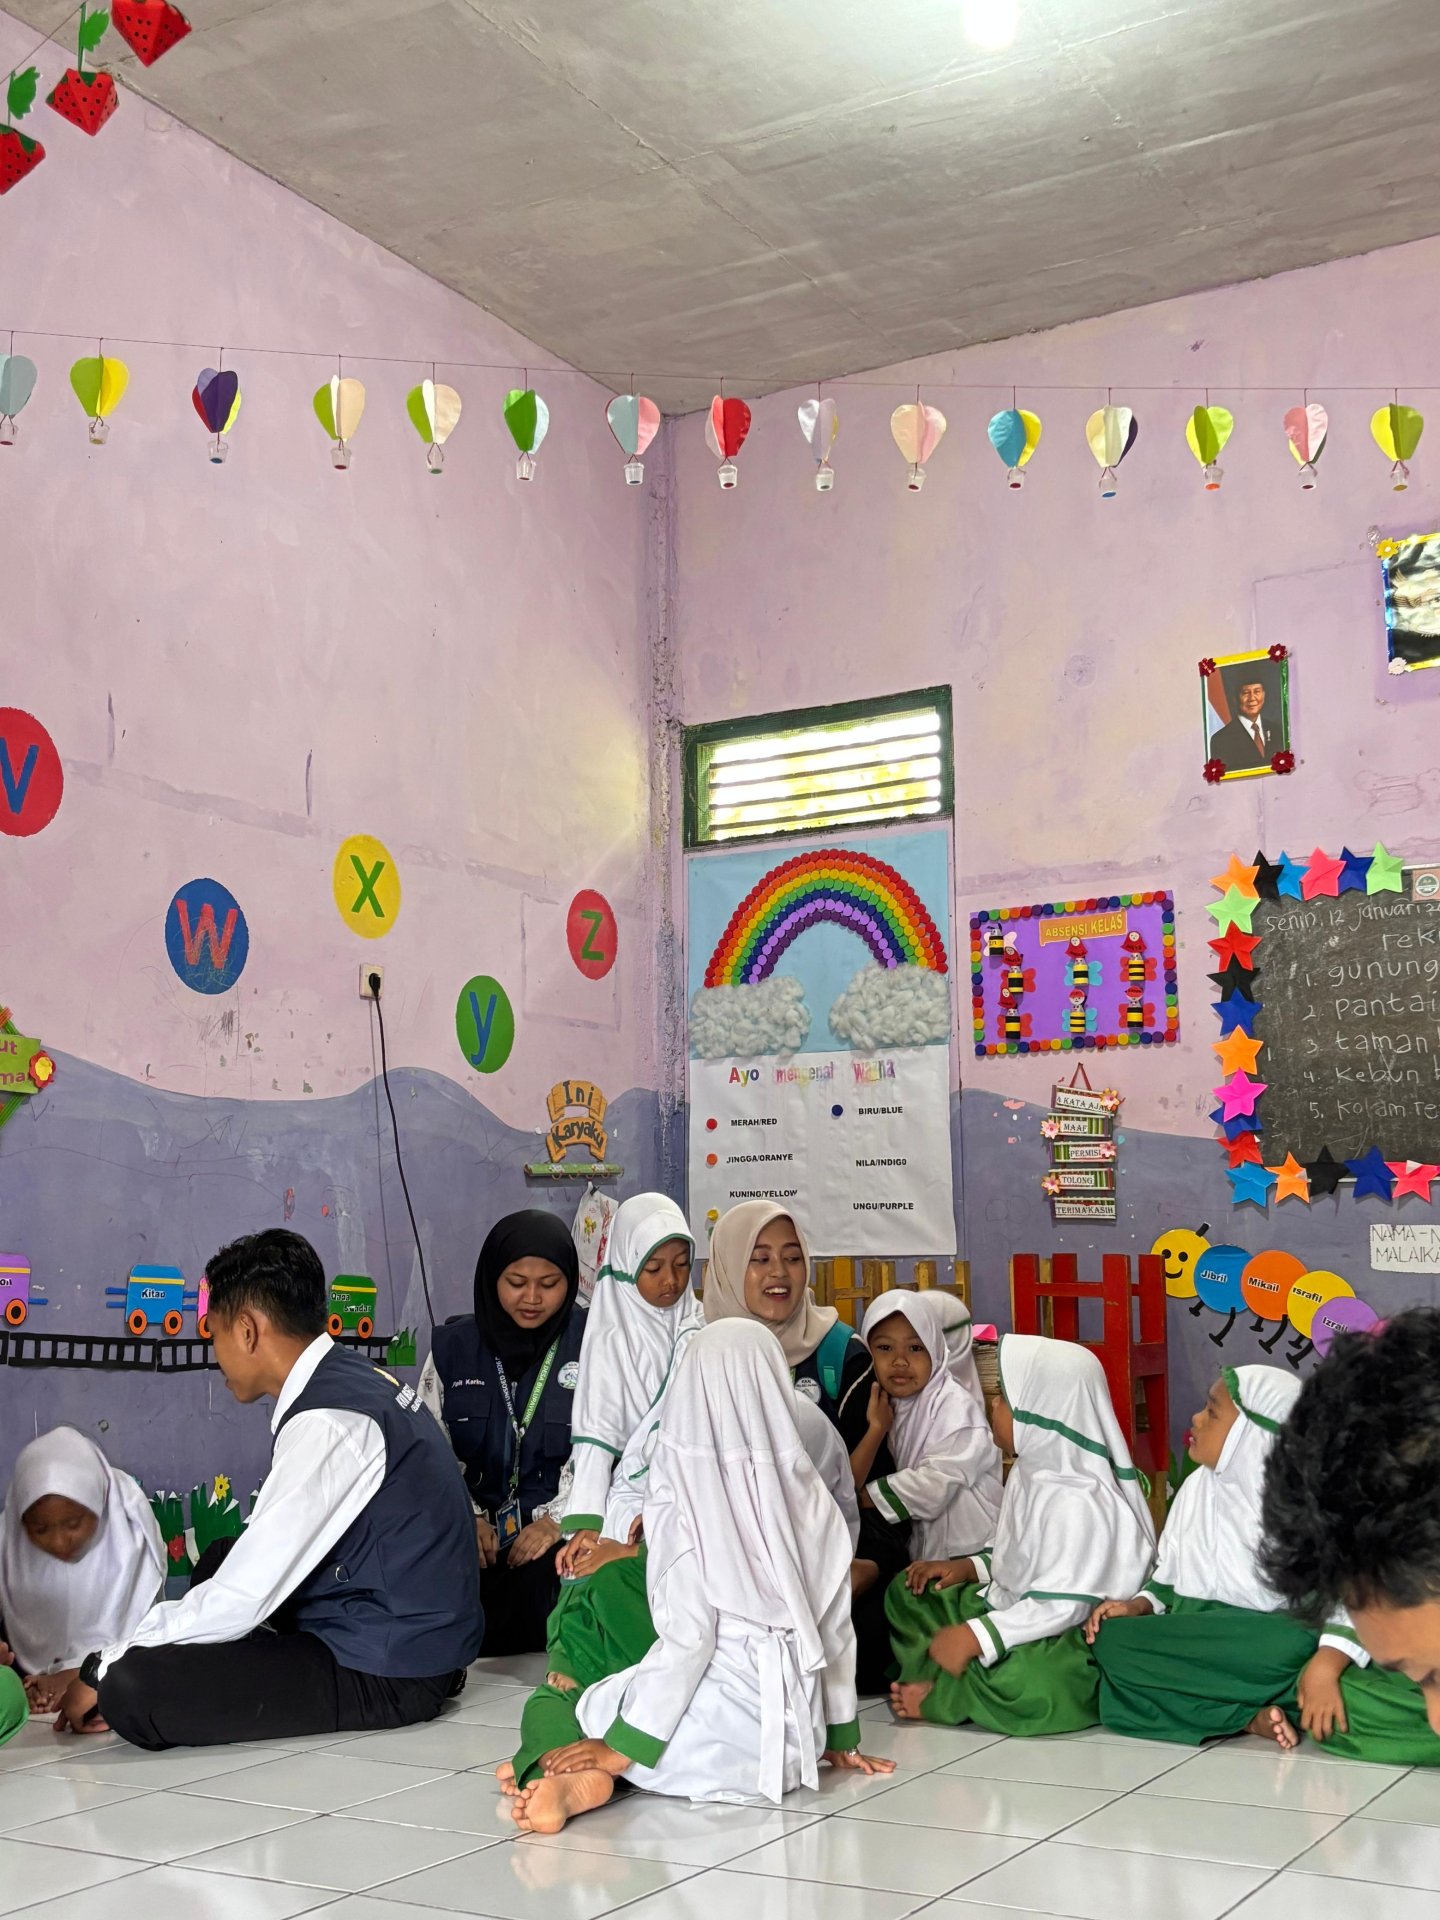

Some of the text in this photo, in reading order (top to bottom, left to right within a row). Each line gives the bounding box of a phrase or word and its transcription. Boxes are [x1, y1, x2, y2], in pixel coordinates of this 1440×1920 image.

[0, 736, 39, 815] V
[350, 855, 385, 918] X
[1046, 914, 1122, 937] ABSENSI KELAS
[176, 899, 238, 969] W
[1328, 959, 1439, 987] gunung
[1335, 990, 1438, 1020] pantai
[1335, 1030, 1428, 1054] taman
[729, 1067, 760, 1087] Ayo
[563, 1080, 594, 1106] Ini
[1063, 1097, 1086, 1107] KATA
[858, 1106, 903, 1115] BIRU/BLUE
[731, 1118, 777, 1126] MERAH/RED
[1064, 1124, 1088, 1132] MAAF
[726, 1154, 793, 1163] JINGGA/ORANYE
[855, 1159, 907, 1167] NILA/INDIGO
[729, 1190, 797, 1198] KUNING/YELLOW
[853, 1202, 914, 1210] UNGU/PURPLE
[1372, 1225, 1416, 1241] NAMA
[1201, 1270, 1228, 1283] Jibril
[1248, 1277, 1280, 1293] Mikail
